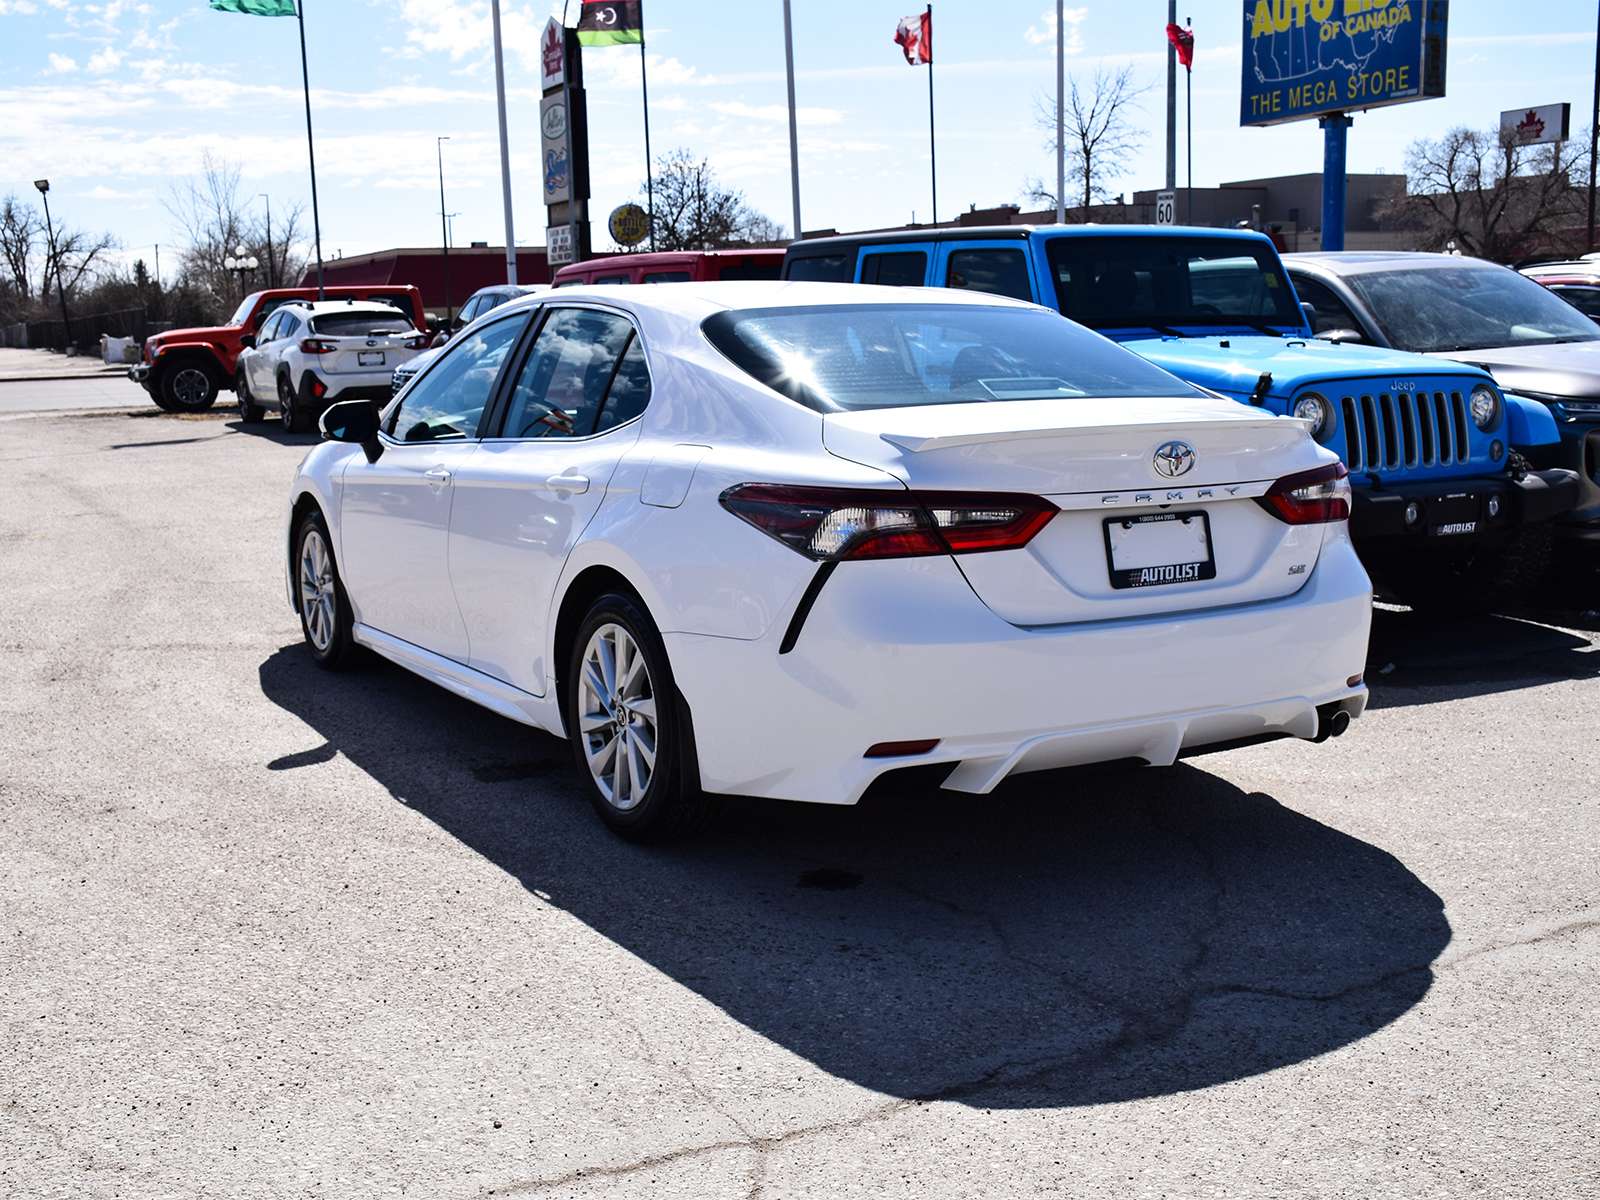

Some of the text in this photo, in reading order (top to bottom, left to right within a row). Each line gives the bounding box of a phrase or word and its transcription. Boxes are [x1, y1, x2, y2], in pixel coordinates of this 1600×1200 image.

[1319, 22, 1340, 42] OF
[1345, 4, 1412, 36] CANADA
[1250, 65, 1410, 115] THE MEGA STORE
[1158, 203, 1172, 223] 60
[1391, 379, 1416, 392] Jeep
[1101, 485, 1240, 505] CAMRY
